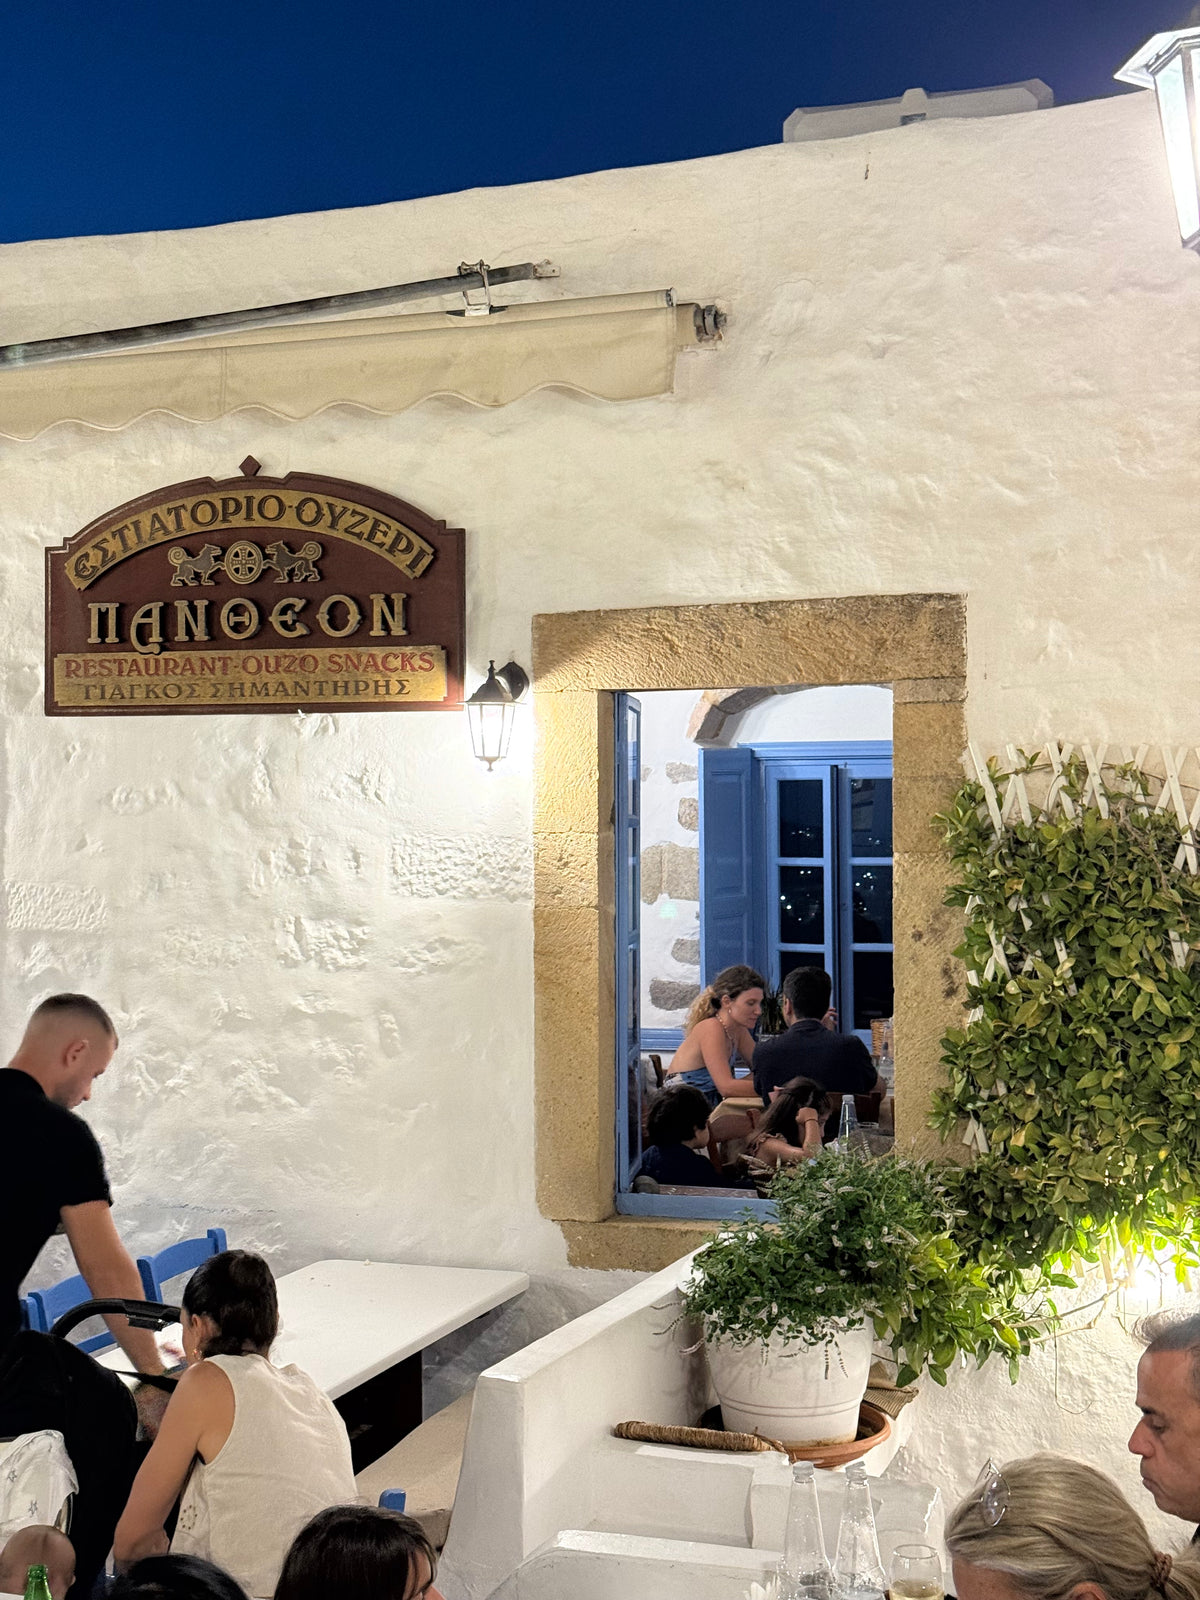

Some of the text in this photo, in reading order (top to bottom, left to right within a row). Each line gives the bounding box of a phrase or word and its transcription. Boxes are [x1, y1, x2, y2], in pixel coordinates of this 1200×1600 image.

[87, 593, 408, 653] ΠΑΝΘΕΟΝ
[327, 651, 435, 673] SNACKS
[82, 679, 411, 700] ΓΙΑΓΚΟΣ ΣΗΜΑΝΤΗΡΗΣ
